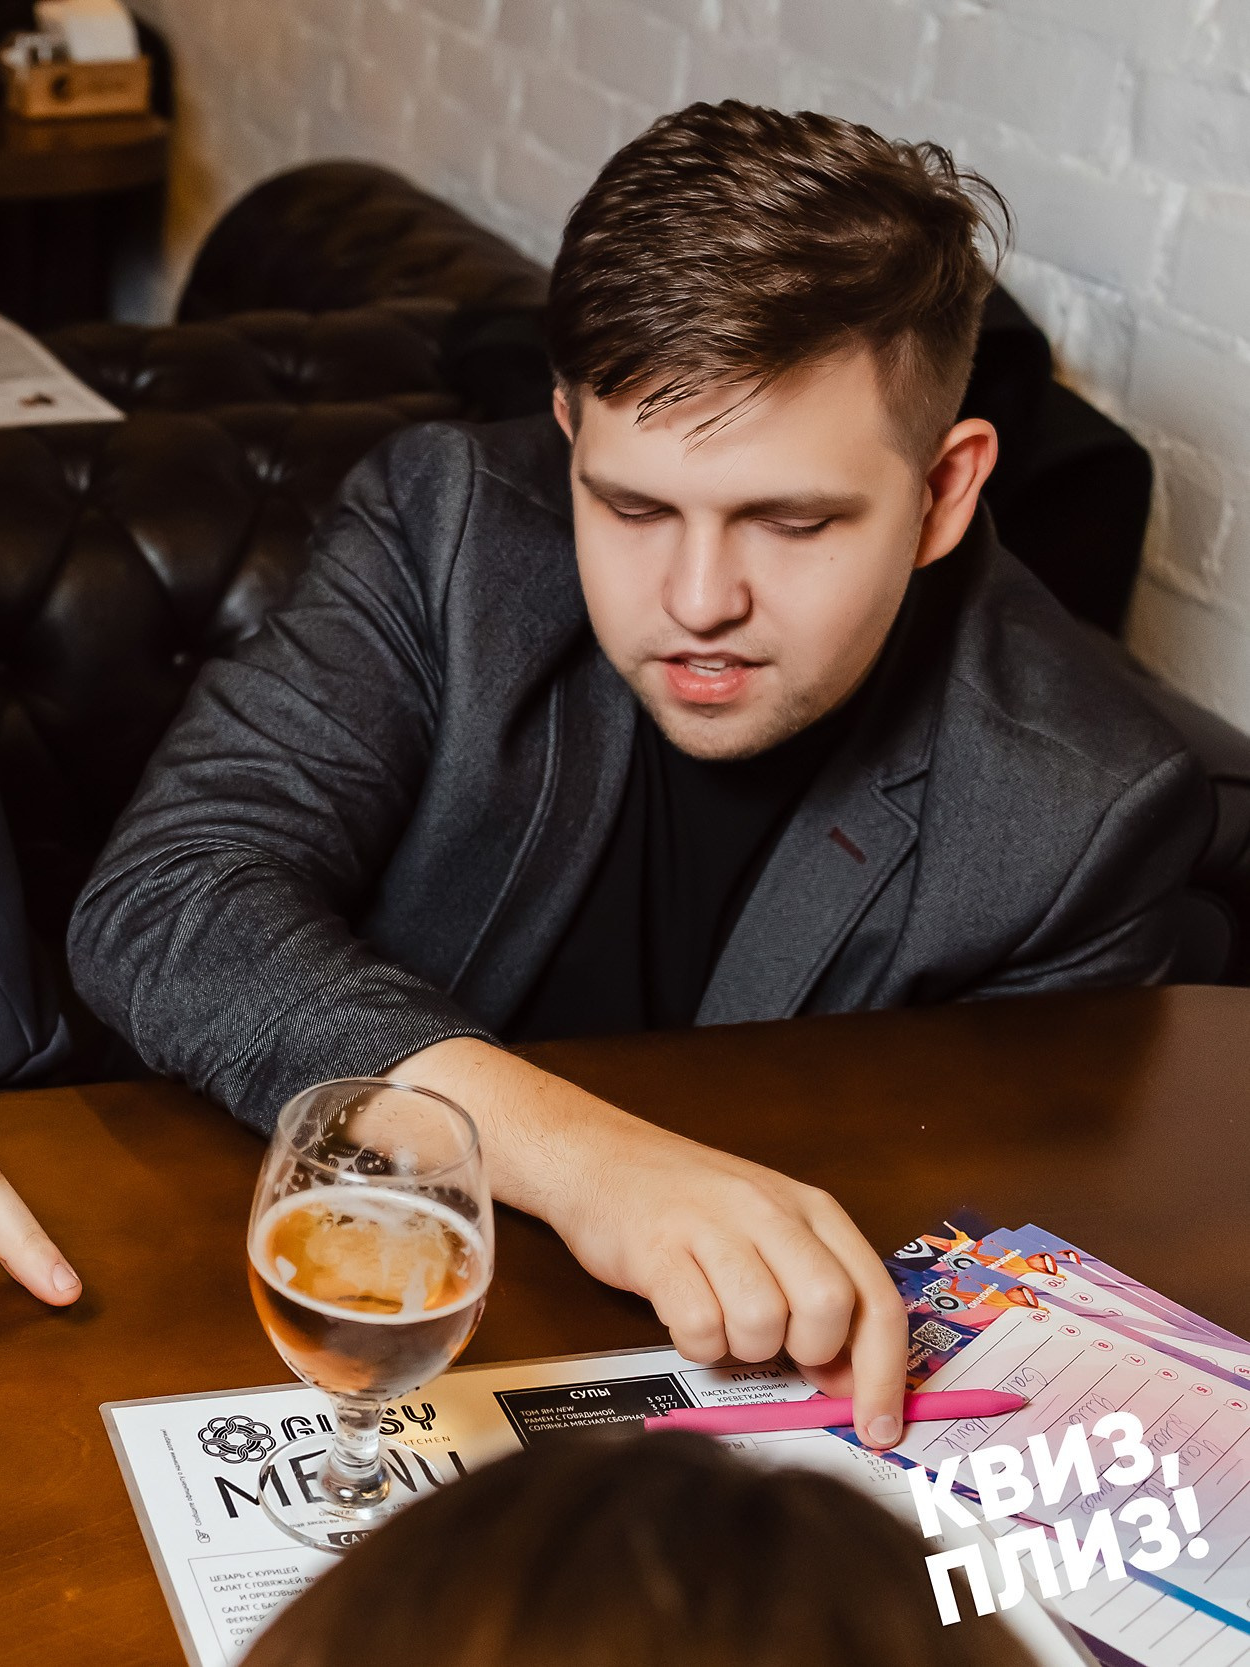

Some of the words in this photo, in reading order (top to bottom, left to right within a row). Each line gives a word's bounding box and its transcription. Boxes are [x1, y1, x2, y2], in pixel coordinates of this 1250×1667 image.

[1032, 1312, 1046, 1322] 10
[731, 1370, 782, 1382] ПАСТЫ
[569, 1387, 611, 1399] СУПЫ
[701, 1389, 729, 1397] ПАСТА
[735, 1382, 789, 1393] ТИГРОВЫМИ
[717, 1392, 774, 1403] КРЕВЕТКАМИ
[520, 1409, 539, 1417] ТОМ
[540, 1407, 555, 1415] ЯМ
[556, 1405, 575, 1413] NEW
[654, 1394, 673, 1403] 977
[524, 1415, 554, 1425] РАМЕН
[562, 1408, 616, 1420] ГОВЯДИНОЙ
[659, 1401, 678, 1410] 977
[281, 1402, 437, 1442] GISY
[528, 1422, 569, 1432] СОЛЯНКА
[570, 1417, 606, 1428] МЯСНАЯ
[607, 1413, 647, 1423] СБОРНАЯ
[873, 1465, 892, 1473] 577
[878, 1472, 898, 1480] 577
[209, 1573, 246, 1583] ЦЕЗАРЬ
[255, 1566, 300, 1577] КУРИЦЕЙ
[213, 1583, 242, 1593] САЛАТ
[253, 1576, 302, 1589] ГОВЯЖЬЕЙ
[249, 1588, 303, 1600] ОРЕХОВЫМ
[222, 1604, 250, 1614] САЛАТ
[225, 1614, 264, 1624] ФЕРМЕР
